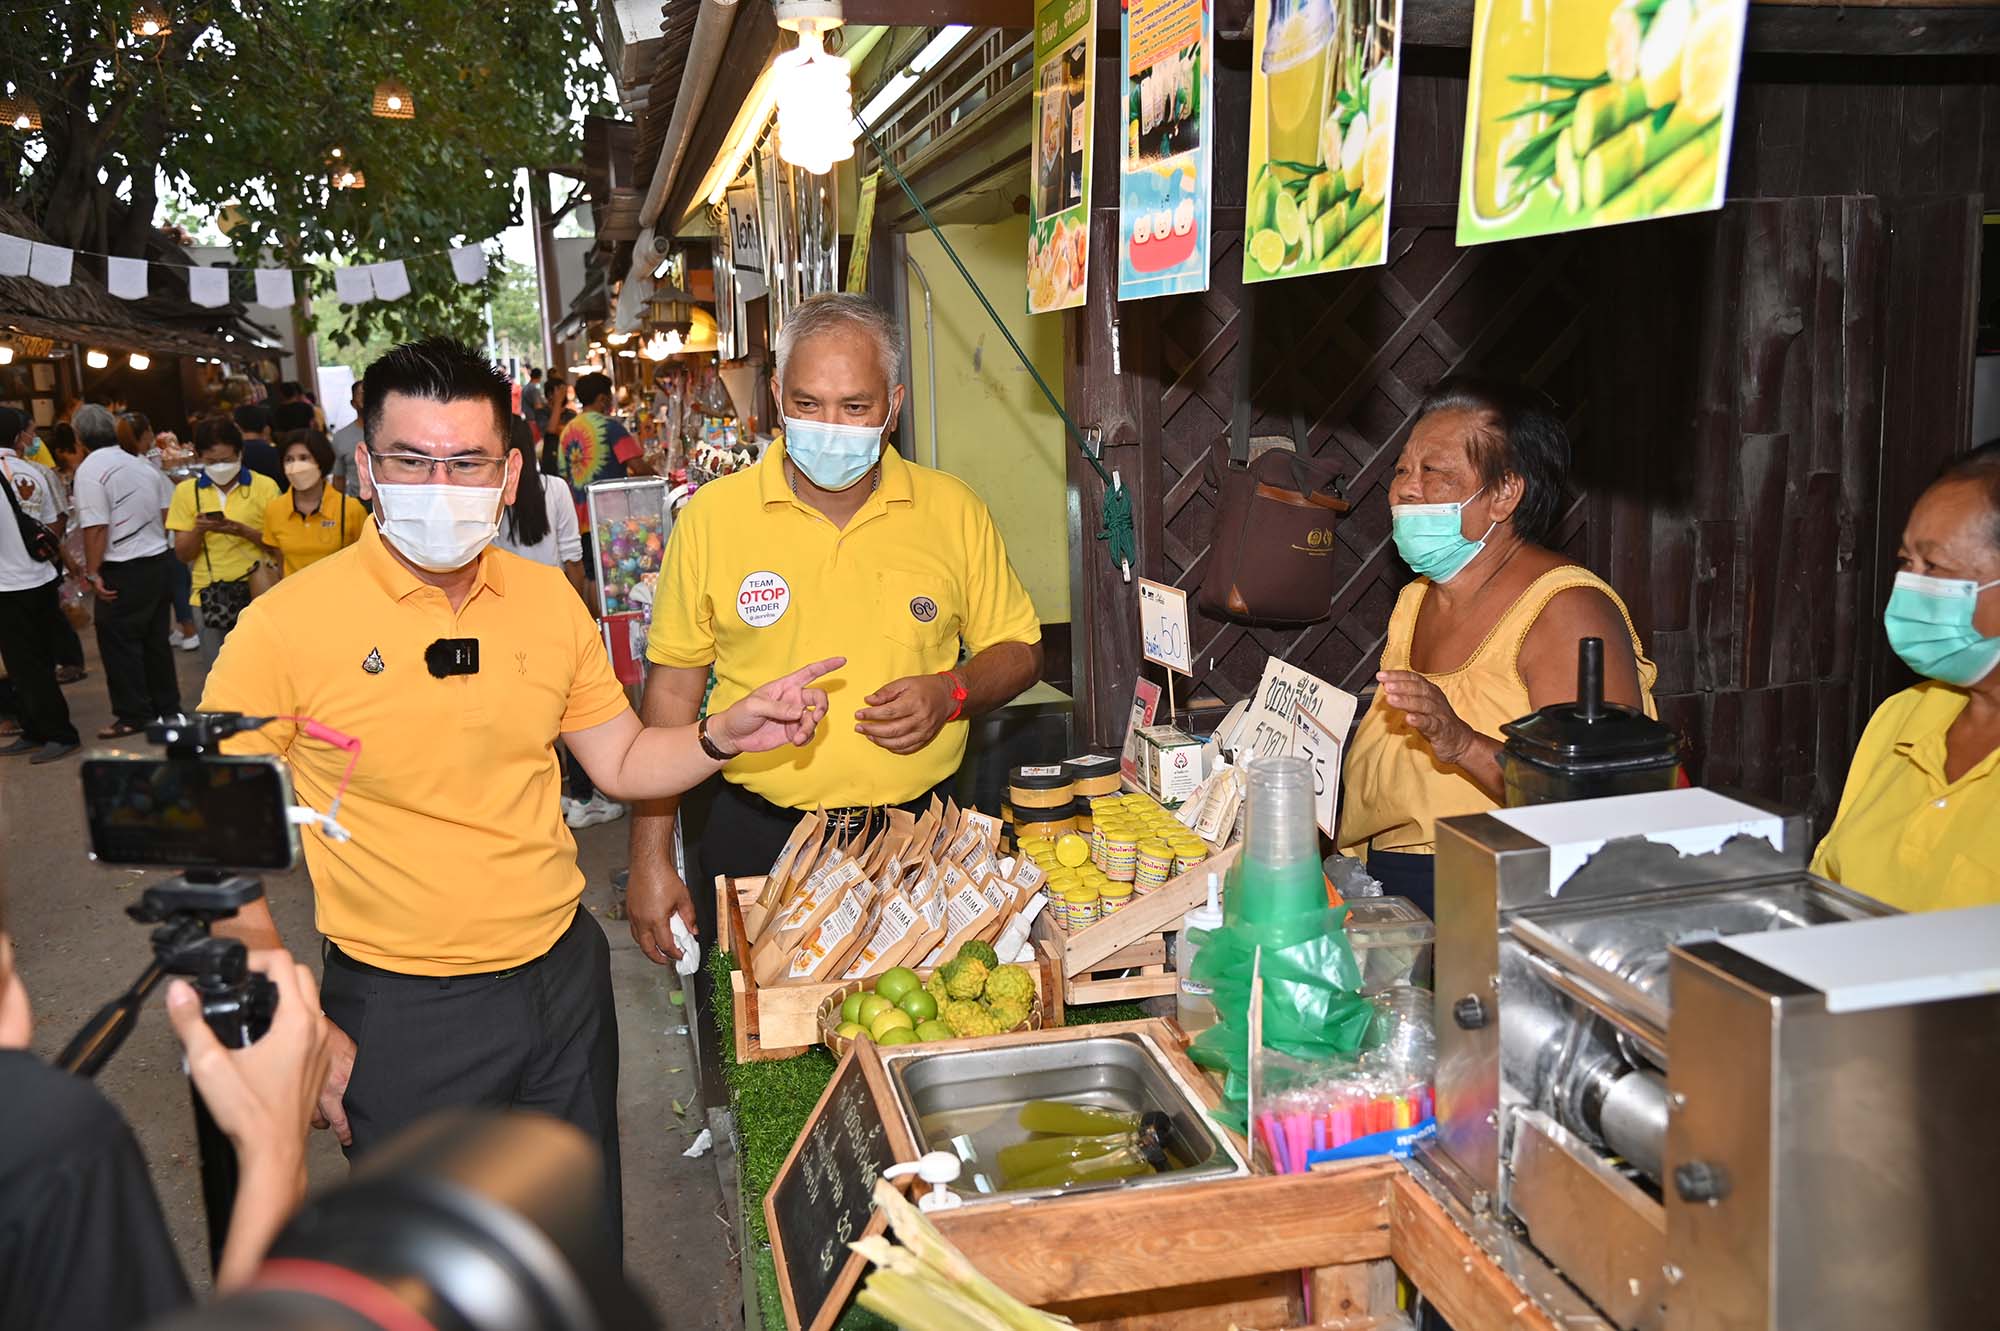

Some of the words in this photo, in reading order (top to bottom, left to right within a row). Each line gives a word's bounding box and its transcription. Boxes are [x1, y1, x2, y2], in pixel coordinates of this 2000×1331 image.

[739, 587, 786, 605] OTOP
[749, 579, 774, 588] TEAM
[744, 602, 780, 614] TRADER
[1161, 616, 1181, 659] 50
[837, 1209, 852, 1244] 30
[820, 1239, 834, 1272] 30
